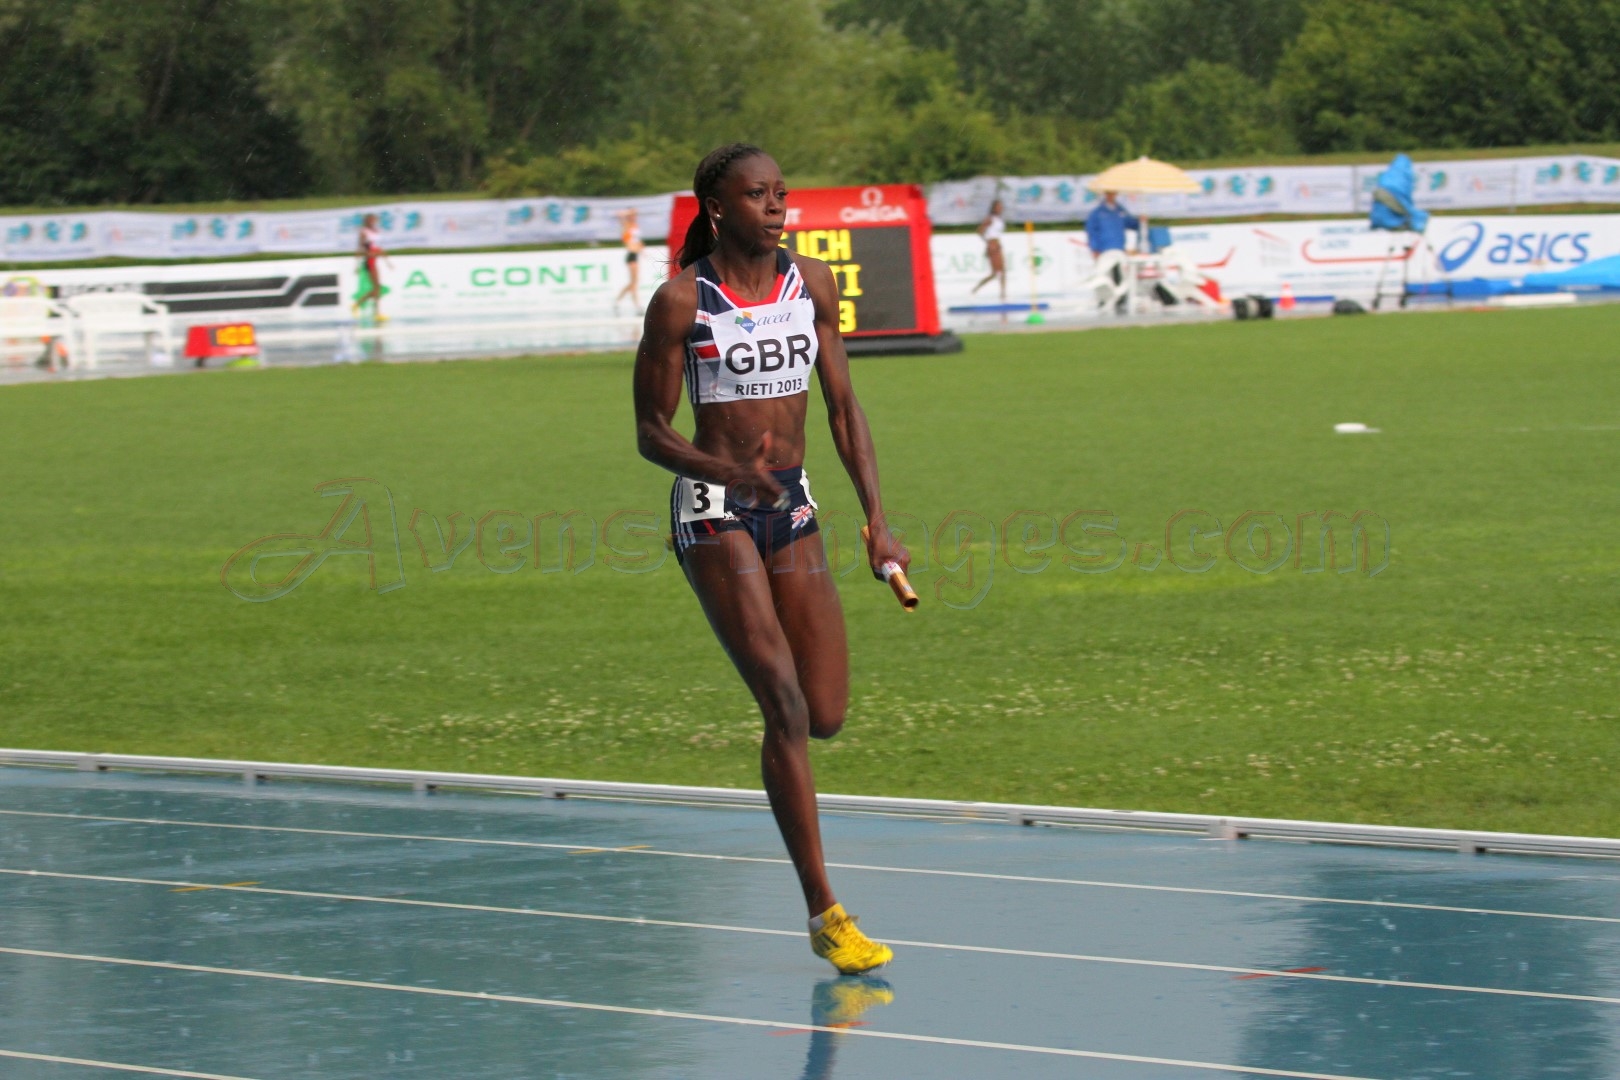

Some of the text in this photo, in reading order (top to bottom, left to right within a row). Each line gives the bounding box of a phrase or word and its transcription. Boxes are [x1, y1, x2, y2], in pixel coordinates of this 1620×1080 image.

[839, 205, 908, 223] OMEGA
[1488, 232, 1592, 264] asics
[470, 264, 610, 288] CONTI
[756, 312, 792, 327] acea
[725, 333, 811, 375] GBR
[735, 378, 802, 396] RIETI 2013
[692, 483, 711, 513] 3
